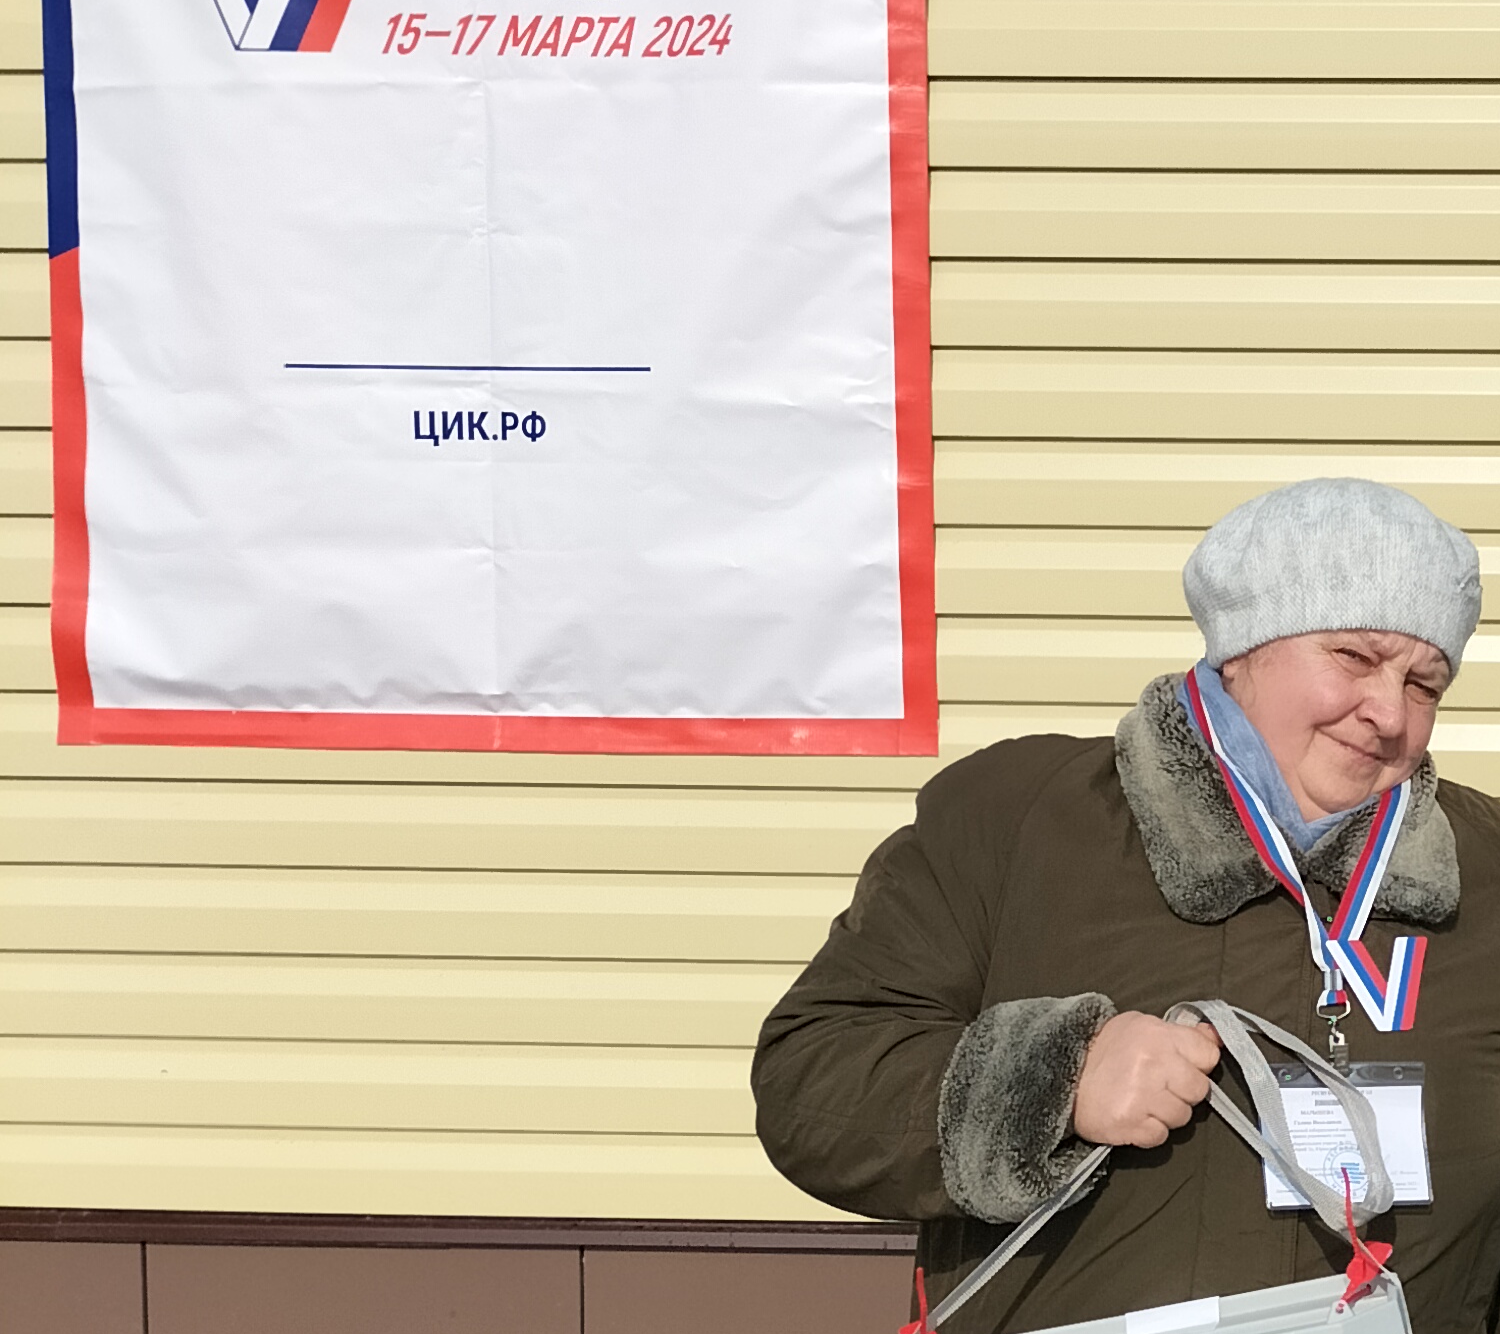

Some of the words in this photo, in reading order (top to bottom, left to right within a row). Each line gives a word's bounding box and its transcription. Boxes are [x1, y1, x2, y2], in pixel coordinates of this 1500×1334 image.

[497, 14, 636, 58] МАРТА
[641, 13, 733, 59] 2024
[413, 410, 547, 447] ЦИК.РФ
